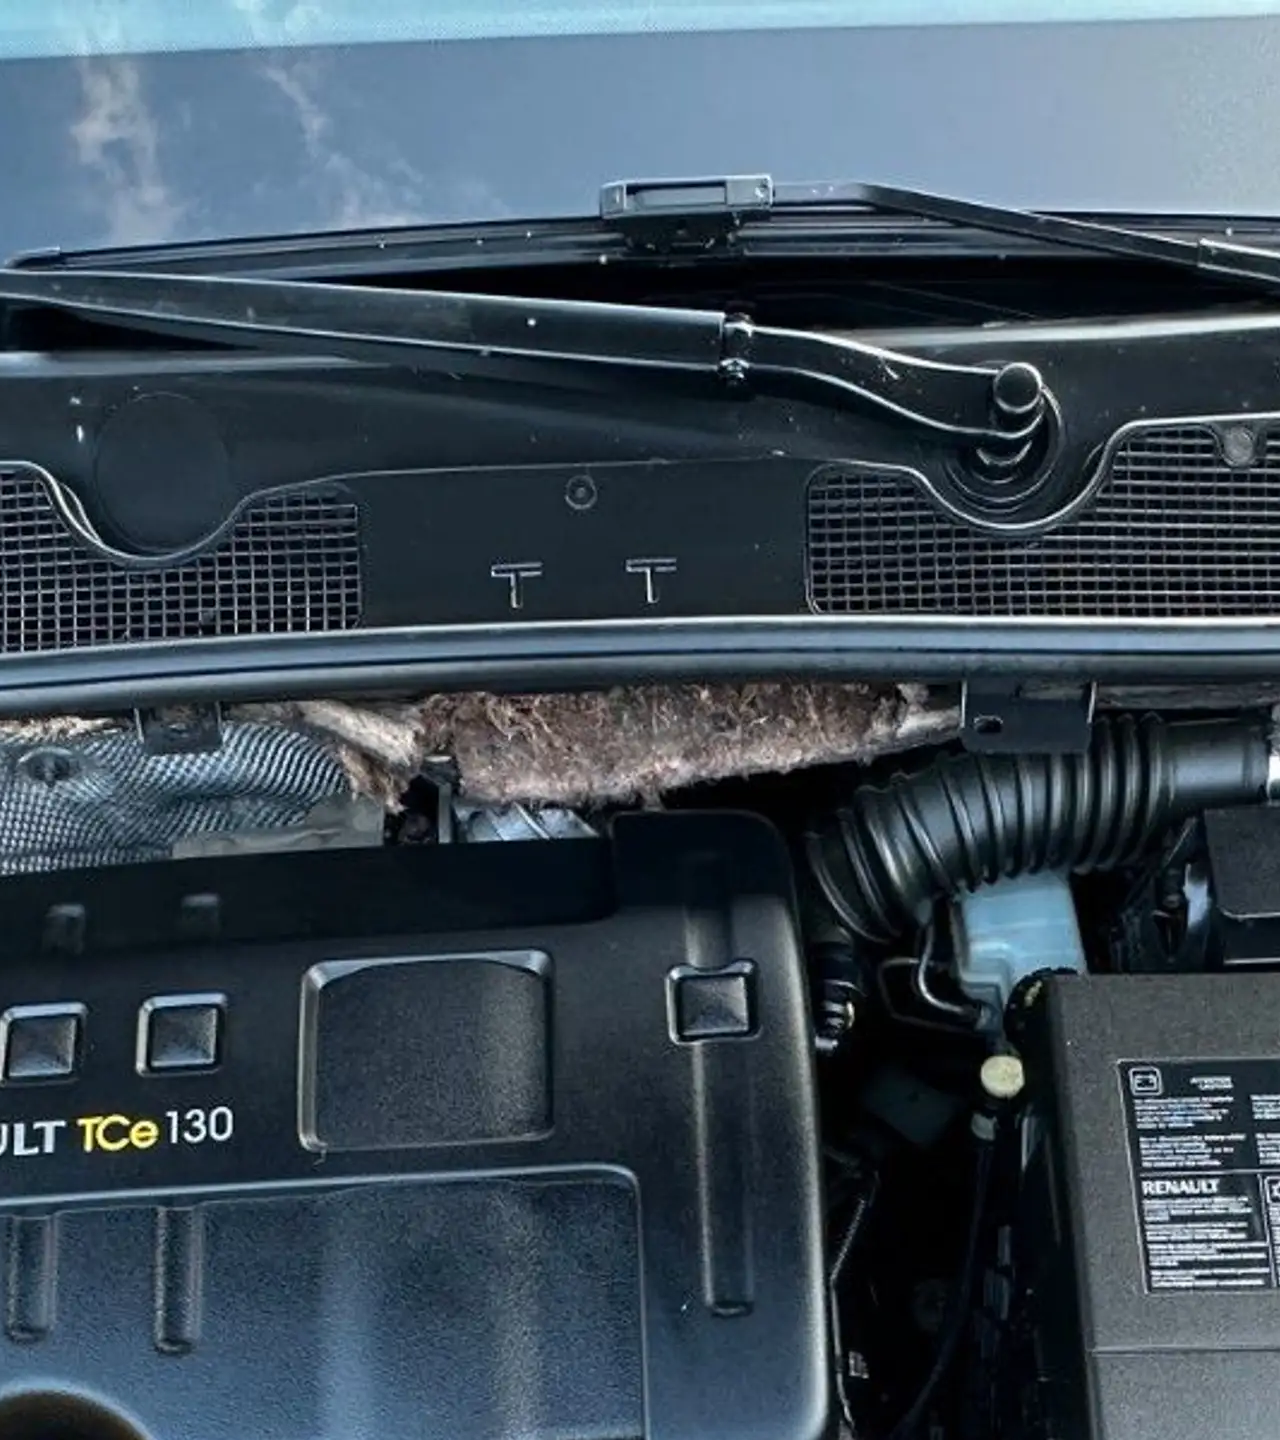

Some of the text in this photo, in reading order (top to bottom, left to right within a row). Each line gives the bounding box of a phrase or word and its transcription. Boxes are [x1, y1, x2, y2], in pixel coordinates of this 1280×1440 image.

[76, 1115, 158, 1153] TCe
[166, 1106, 235, 1144] 130
[1141, 1178, 1221, 1195] RENAULT
